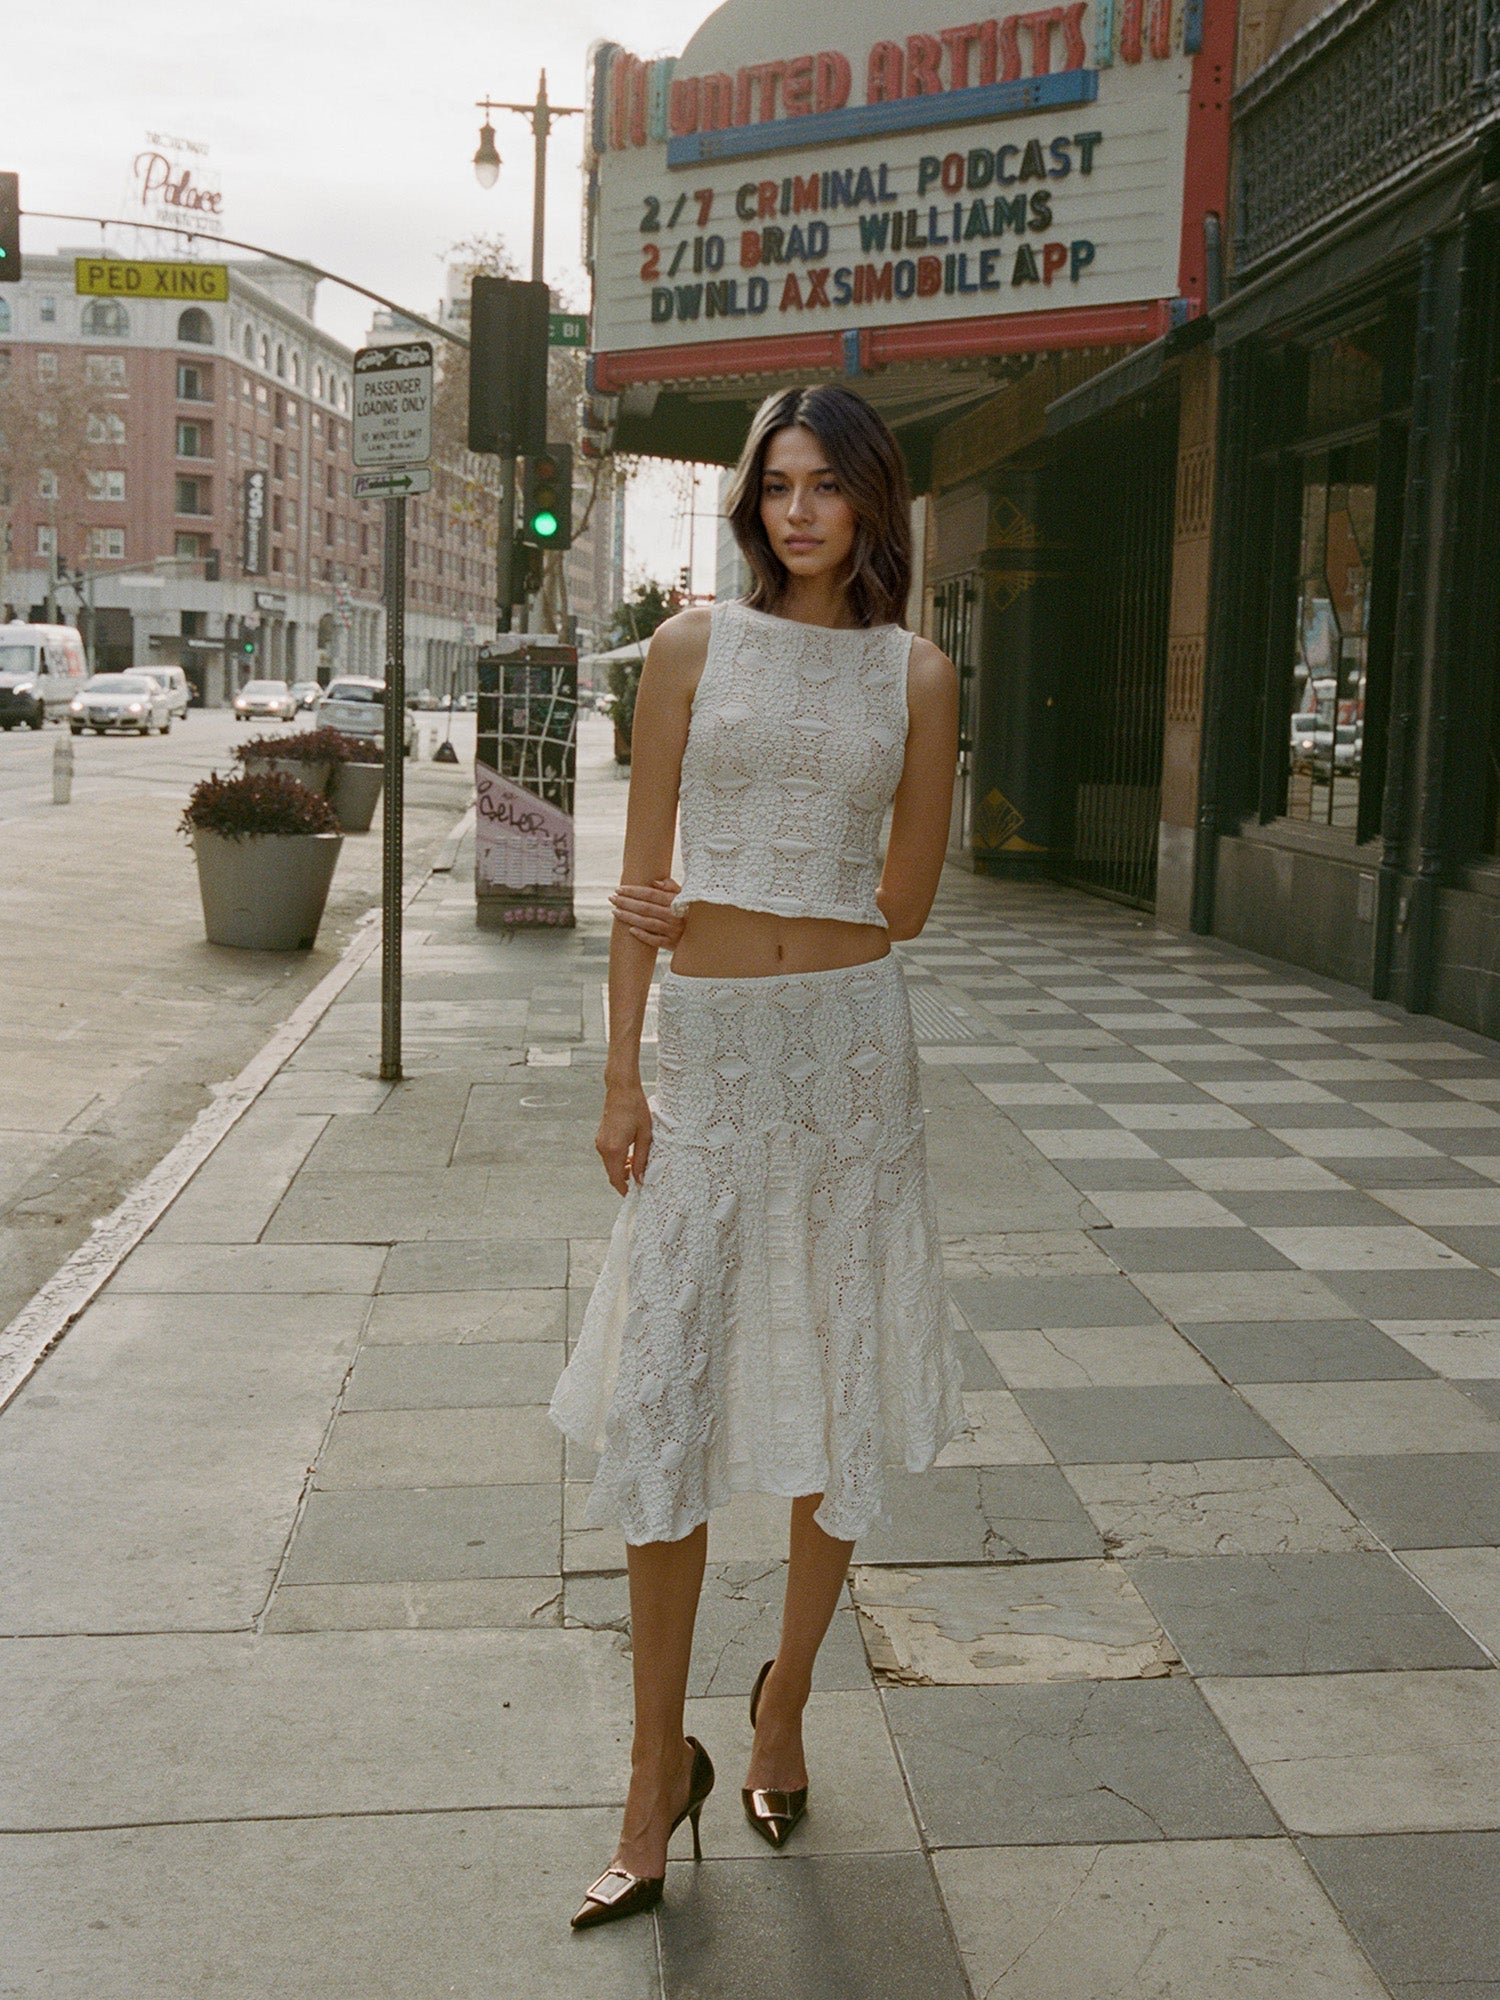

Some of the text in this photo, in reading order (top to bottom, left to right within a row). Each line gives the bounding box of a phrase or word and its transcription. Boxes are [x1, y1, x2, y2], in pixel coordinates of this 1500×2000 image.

[670, 2, 1088, 136] UNITED ARTISTS
[133, 151, 225, 215] Palace
[640, 131, 1103, 233] 2/7 CRIMINAL PODCAST
[640, 190, 1054, 282] 2/10 BRAD WILLIAMS
[88, 266, 216, 294] PED XING
[651, 276, 769, 323] DWNLD
[1010, 240, 1095, 287] APP
[356, 396, 427, 417] LOADING ONLY
[364, 377, 421, 398] PASSENGER
